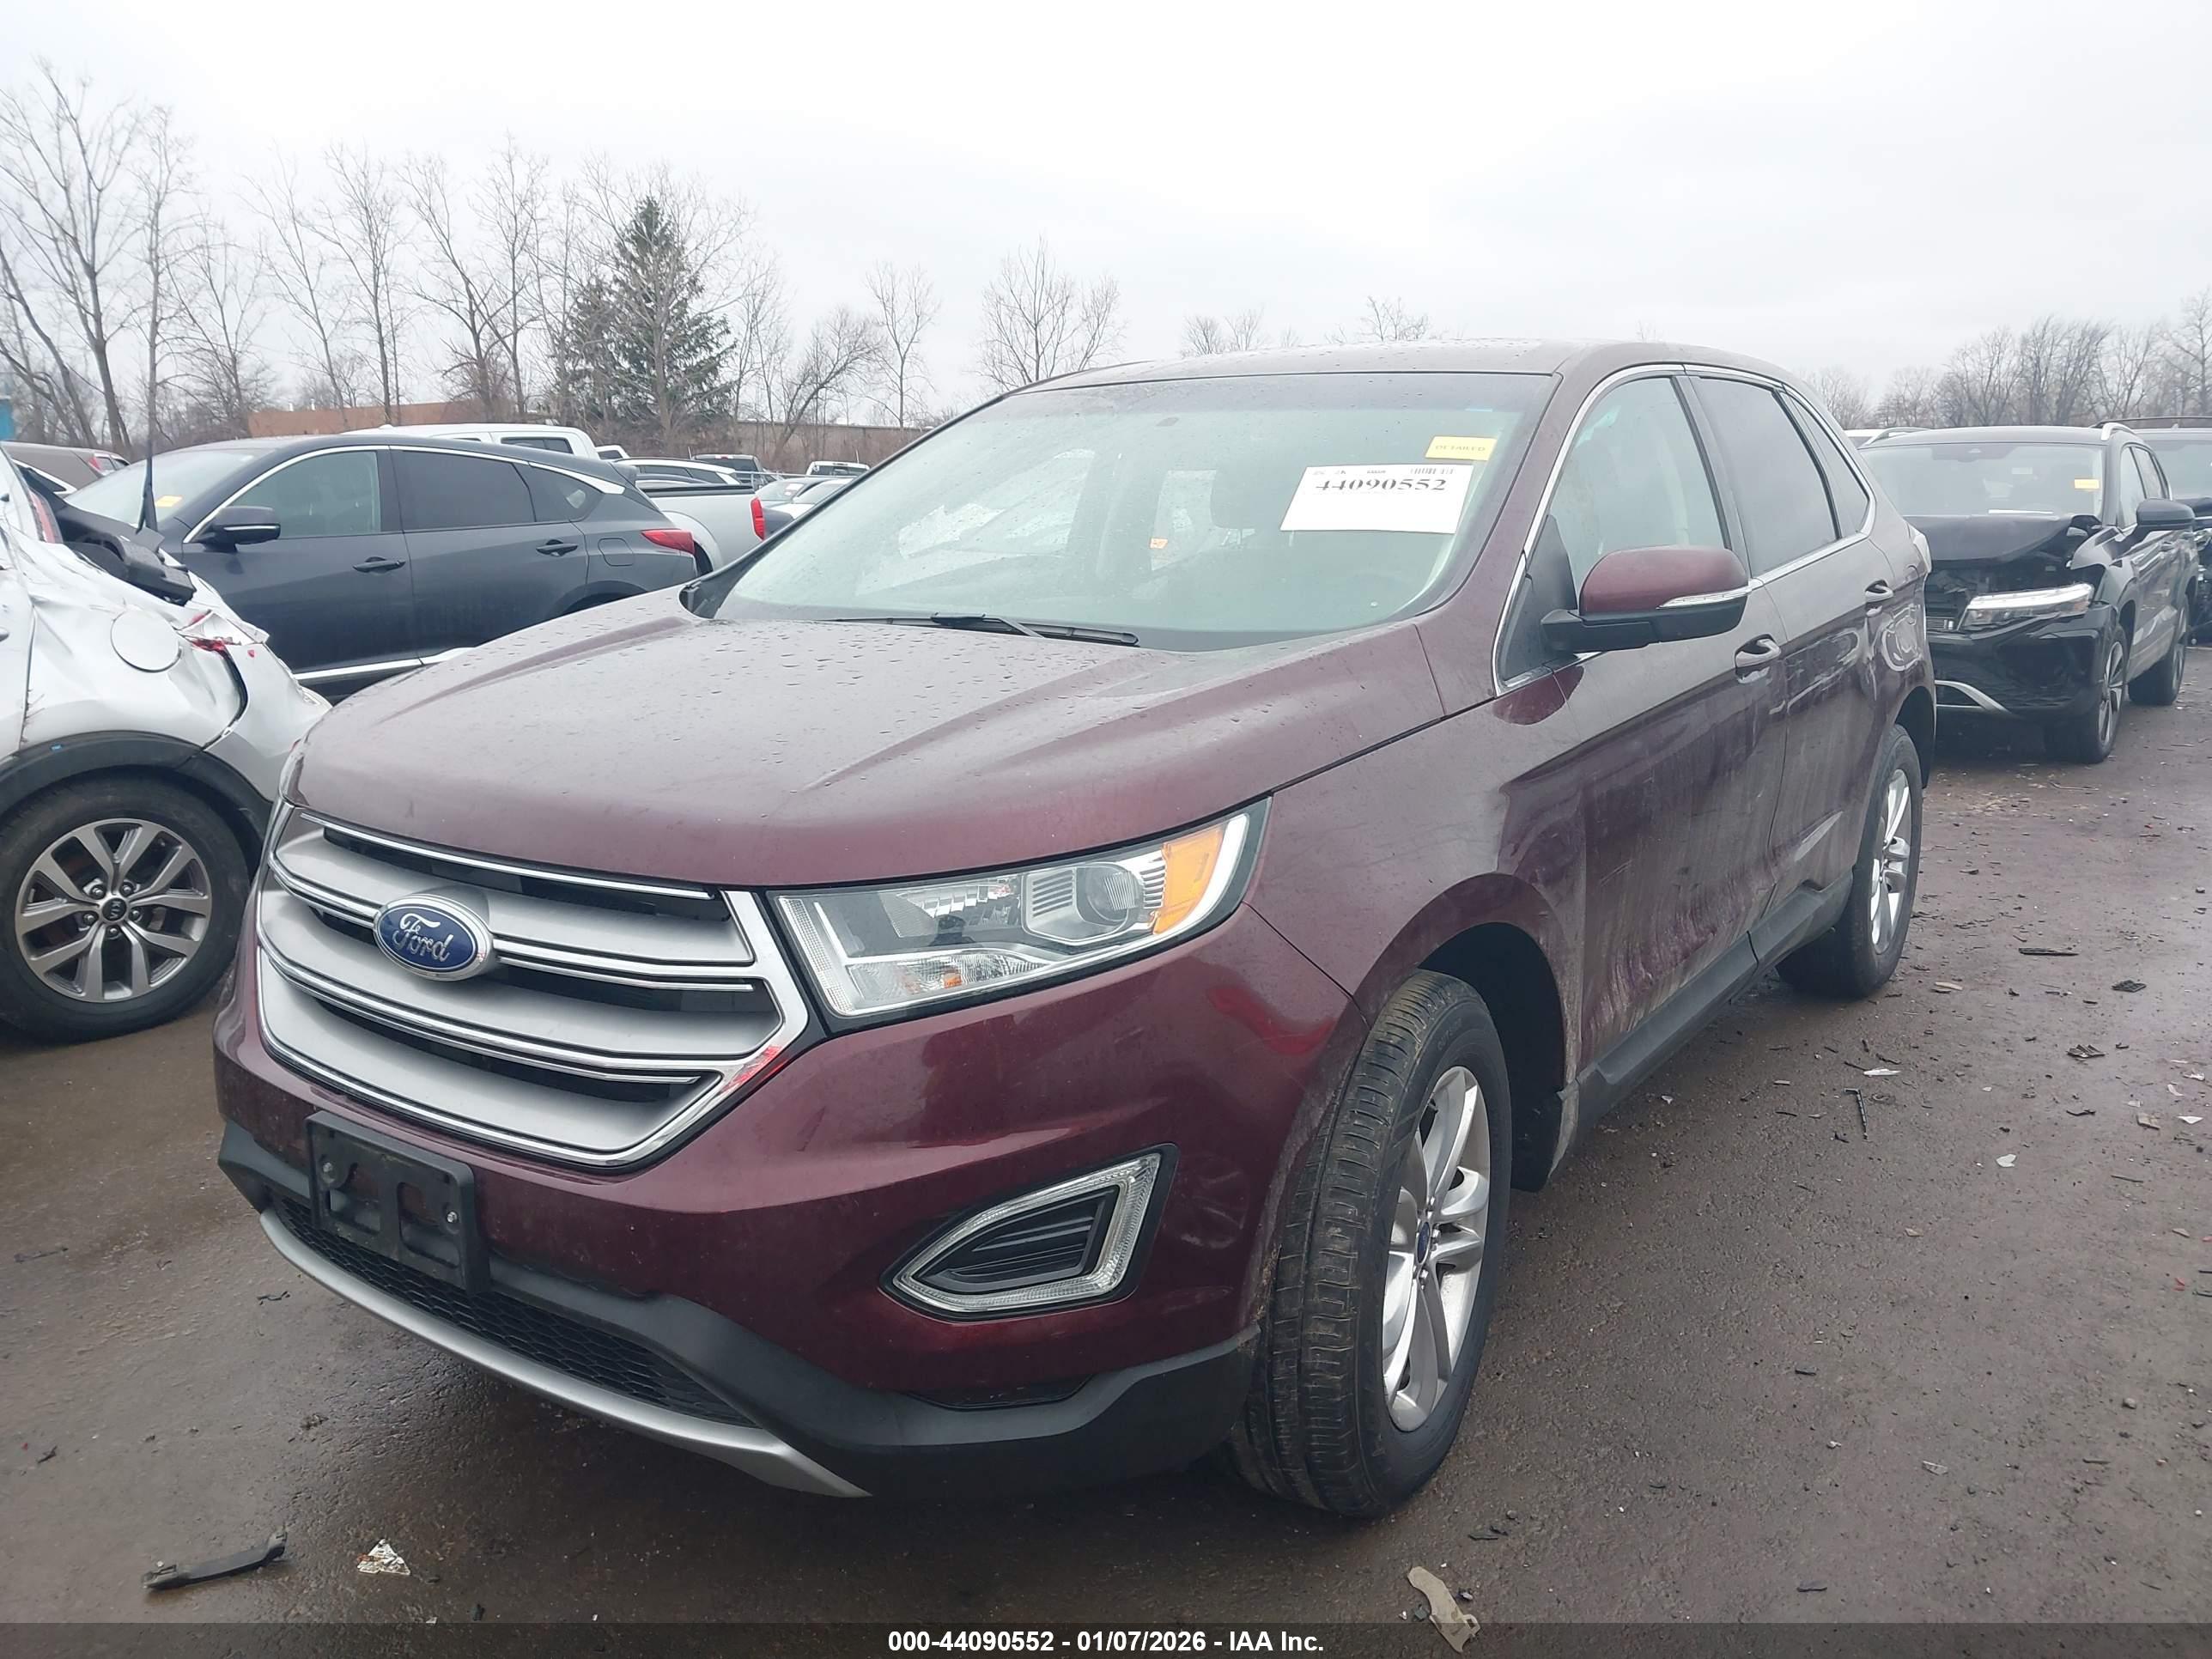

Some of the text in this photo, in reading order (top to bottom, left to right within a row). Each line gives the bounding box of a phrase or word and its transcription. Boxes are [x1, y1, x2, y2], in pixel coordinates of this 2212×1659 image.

[1316, 478, 1448, 491] 44090552
[109, 900, 121, 919] KIA
[392, 912, 454, 963] Ford
